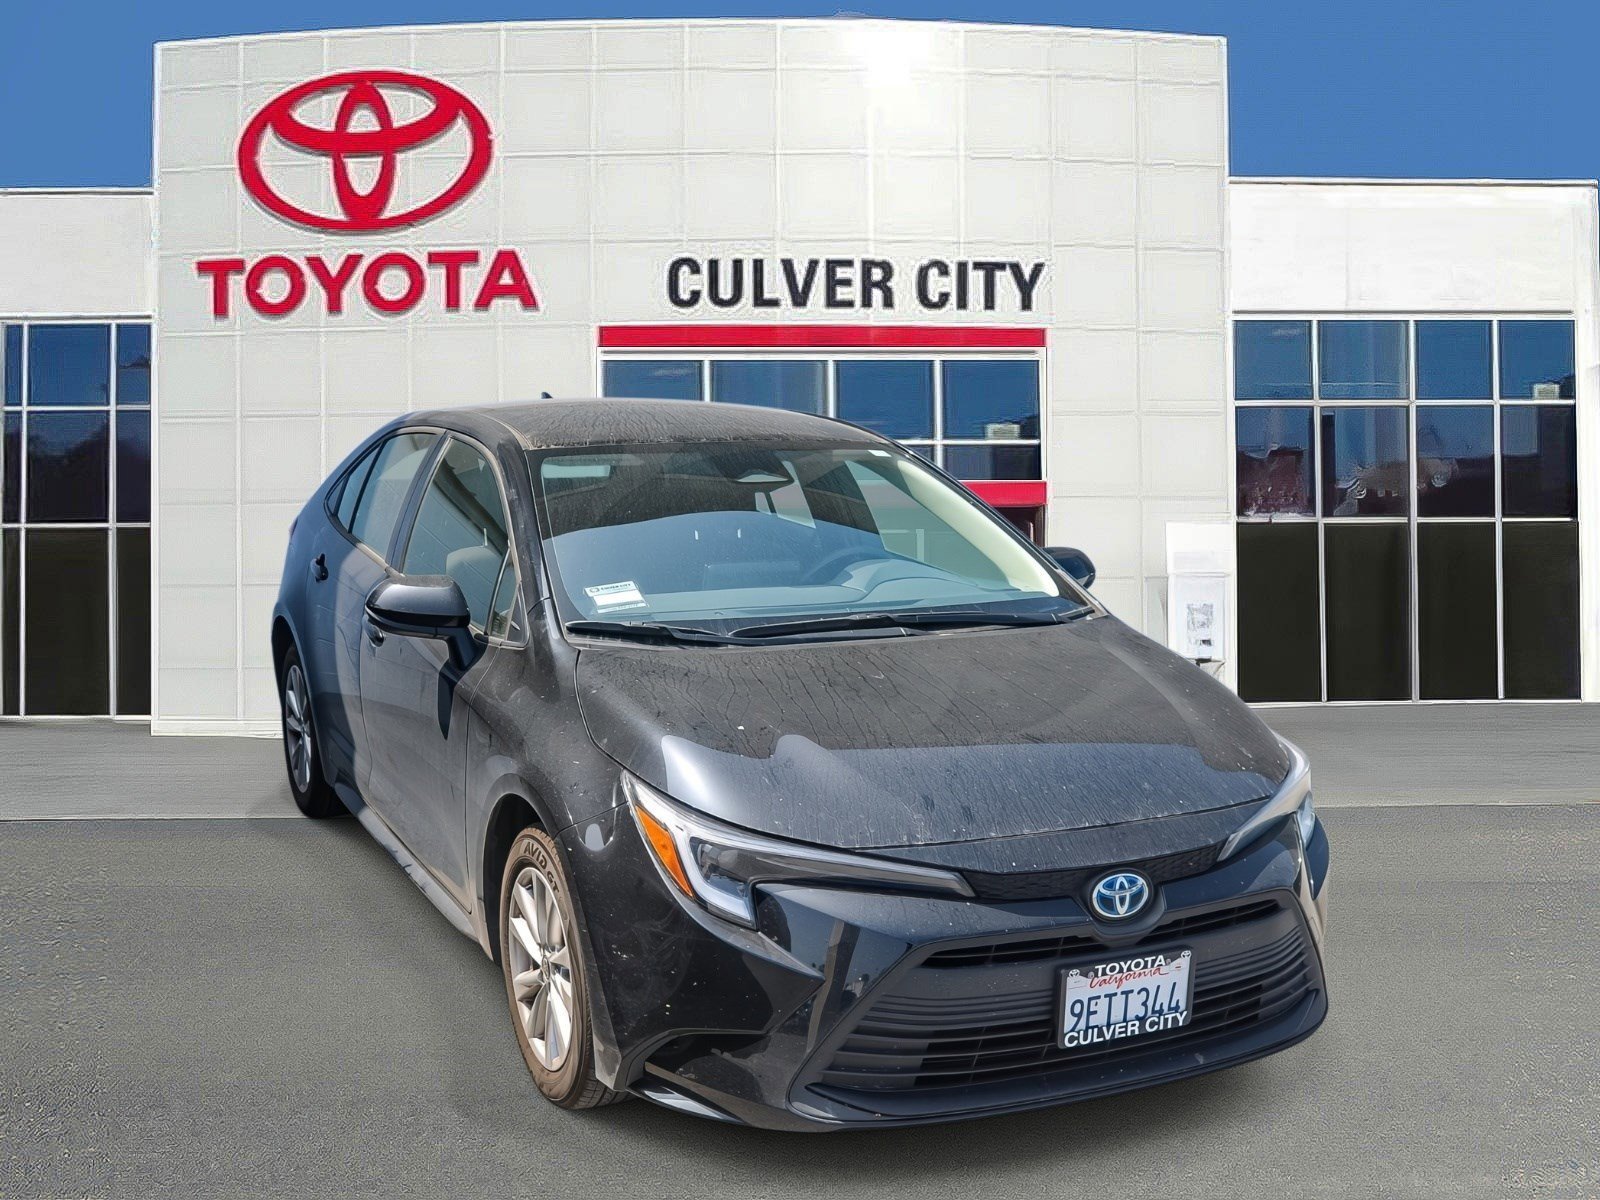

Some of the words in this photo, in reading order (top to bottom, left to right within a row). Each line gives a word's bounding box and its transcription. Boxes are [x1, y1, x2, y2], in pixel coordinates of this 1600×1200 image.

[197, 249, 540, 320] TOYOTA
[667, 257, 895, 310] CULVER
[915, 257, 1046, 312] CITY
[524, 841, 547, 869] AVID
[547, 871, 560, 893] GT
[1089, 966, 1169, 989] California
[1095, 955, 1166, 977] TOYOTA
[1064, 1020, 1139, 1048] CULVER
[1145, 1010, 1188, 1032] CITY
[1068, 981, 1181, 1031] 9ETT344
